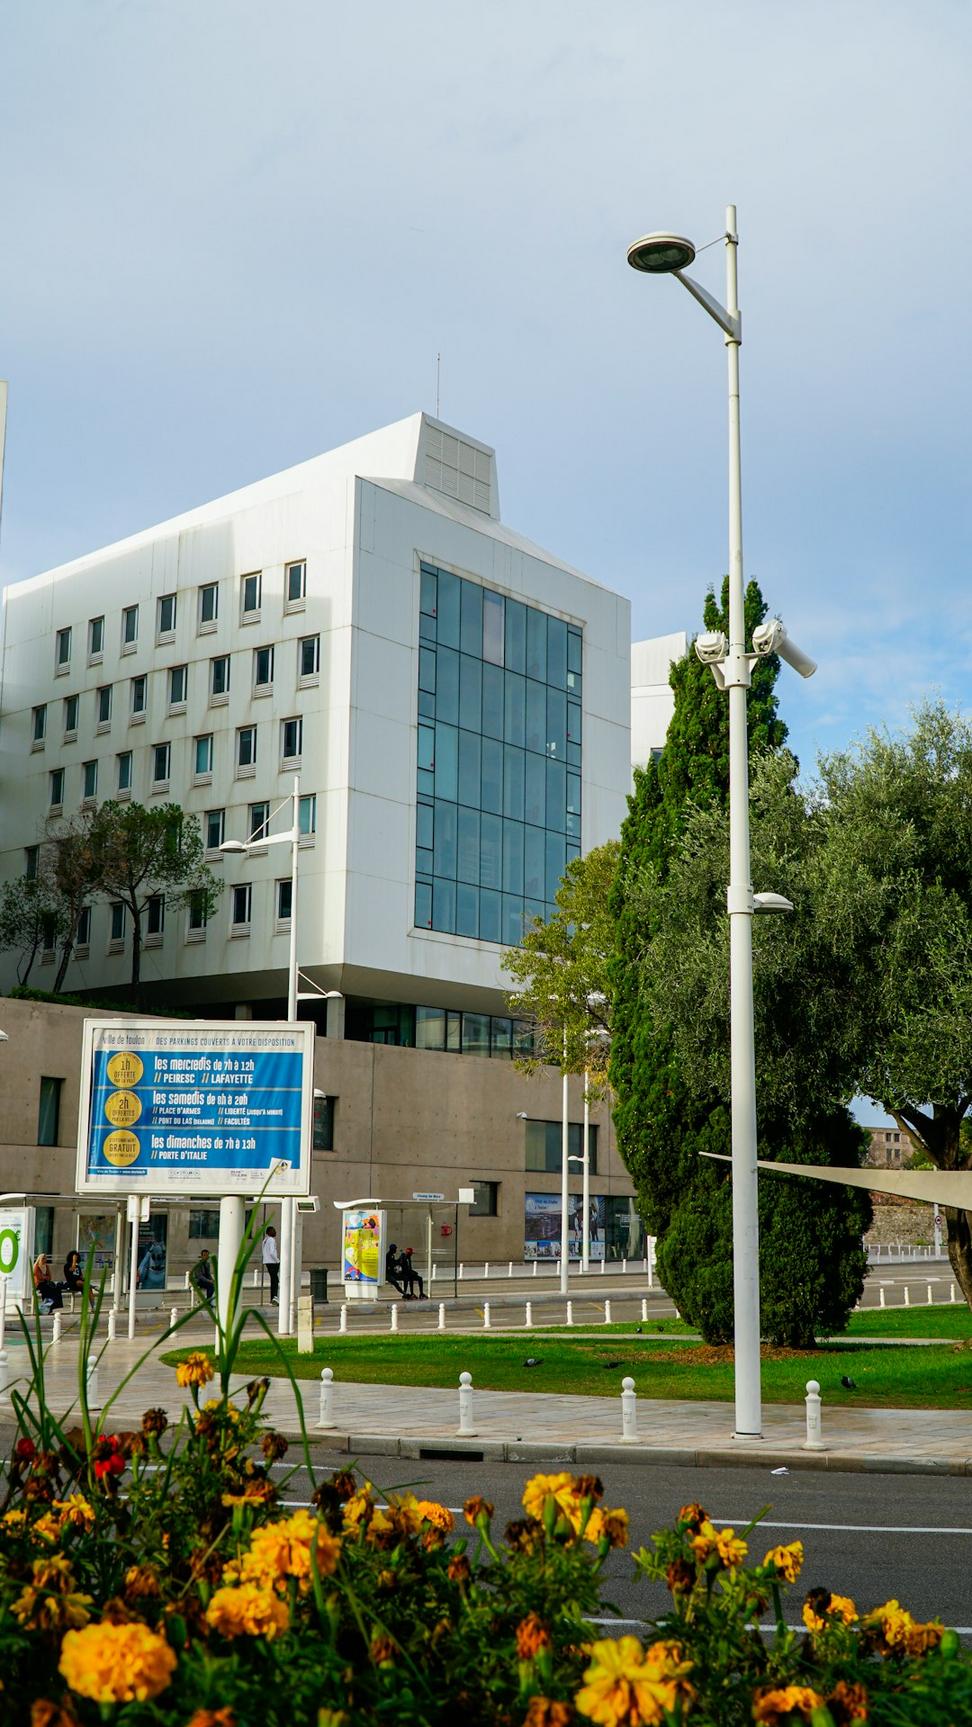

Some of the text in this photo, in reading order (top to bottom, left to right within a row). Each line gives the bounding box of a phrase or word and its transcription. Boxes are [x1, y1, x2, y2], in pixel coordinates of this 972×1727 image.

[156, 1037, 168, 1046] DES
[169, 1037, 198, 1046] PARKINGS
[200, 1038, 230, 1046] COUVERTS
[238, 1038, 256, 1046] VOTRE
[258, 1038, 295, 1047] DISPOSITION
[121, 1058, 130, 1070] 1h
[154, 1056, 168, 1070] les
[170, 1056, 211, 1070] mercredis
[213, 1060, 222, 1070] de
[224, 1060, 232, 1071] 7h
[241, 1060, 254, 1071] 12h
[164, 1073, 195, 1083] PEIRESC
[211, 1074, 253, 1084] LAFAYETTE
[120, 1096, 129, 1109] 2h
[153, 1090, 166, 1104] les
[168, 1090, 204, 1104] samedis
[207, 1093, 216, 1104] de
[234, 1093, 248, 1105] 20h
[224, 1117, 250, 1125] FACULTÉS
[152, 1134, 164, 1148] les
[166, 1135, 212, 1149] dimanches
[214, 1137, 223, 1149] de
[225, 1137, 234, 1149] 7h
[109, 1144, 136, 1152] GRATUIT
[159, 1151, 178, 1160] PORTE
[180, 1150, 207, 1160] D'ITALIE
